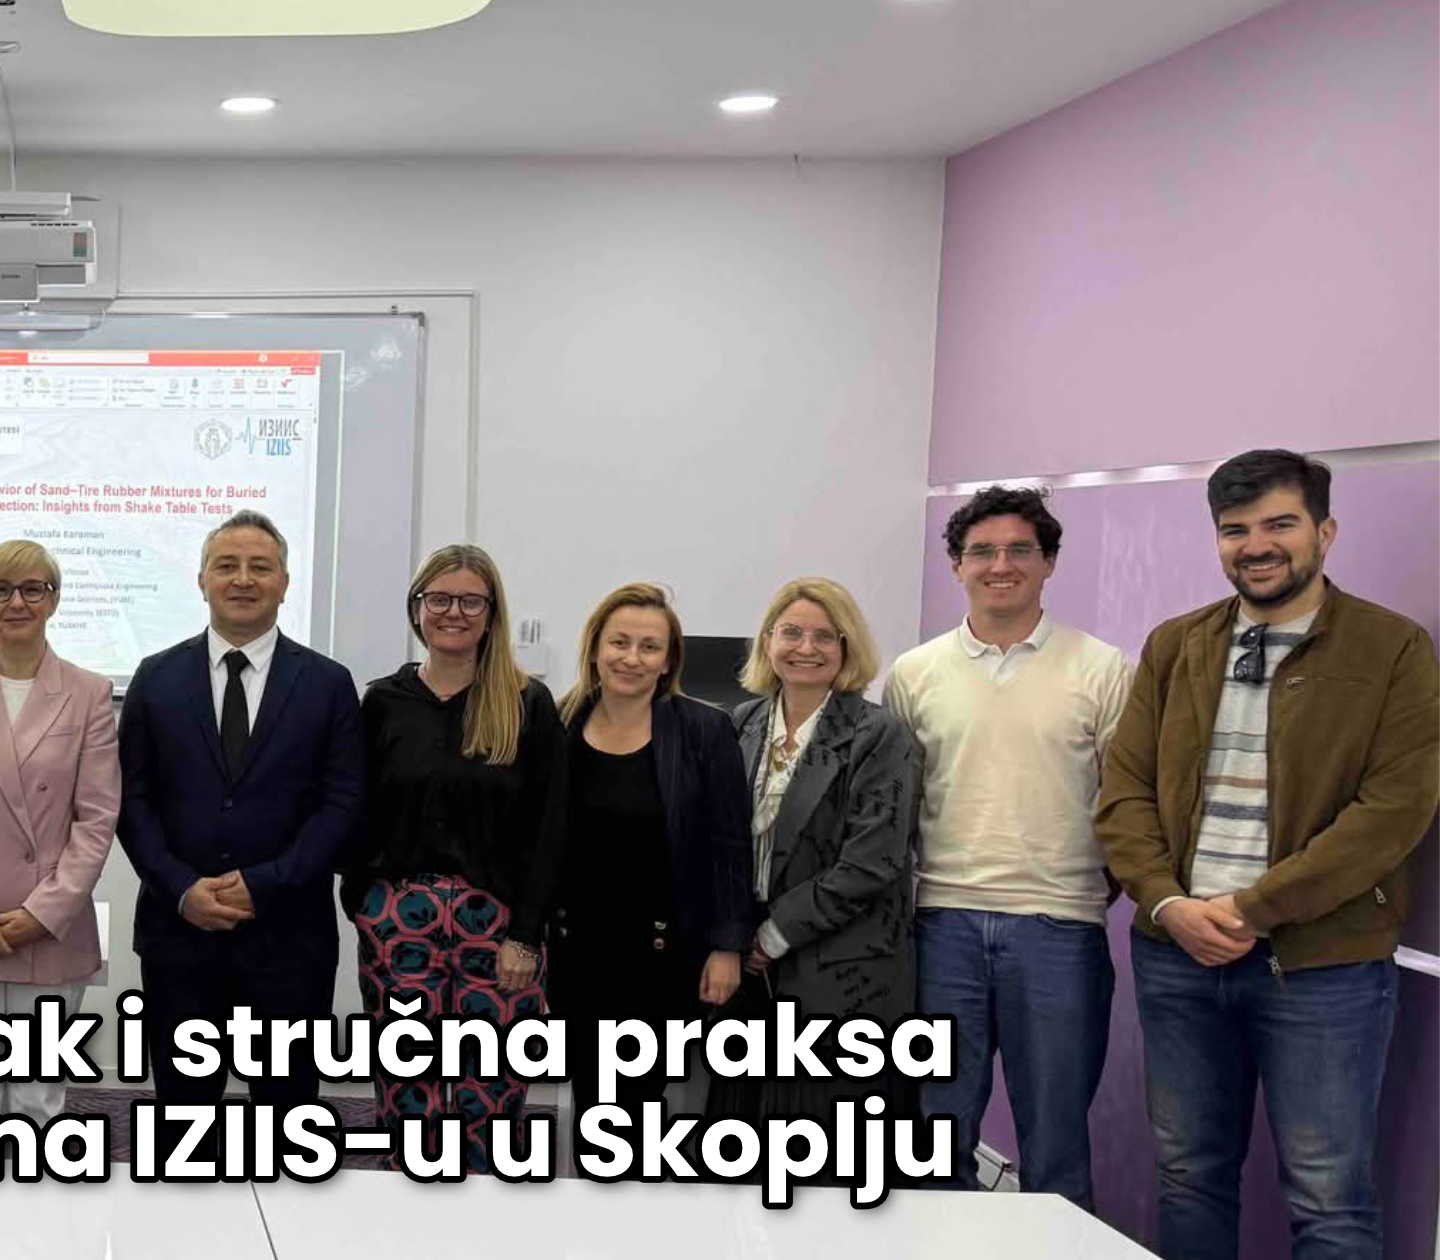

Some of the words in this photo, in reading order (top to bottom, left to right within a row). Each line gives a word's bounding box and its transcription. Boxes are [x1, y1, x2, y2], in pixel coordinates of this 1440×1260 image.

[266, 438, 292, 456] IZIIS
[24, 484, 37, 496] of
[103, 485, 148, 497] Rubber
[150, 485, 202, 498] Mixtures
[205, 486, 223, 498] for
[226, 486, 267, 498] Buried
[42, 500, 90, 514] Insights
[93, 500, 122, 513] from
[124, 501, 162, 513] Shake
[165, 501, 197, 514] Table
[201, 502, 233, 514] Tests
[86, 546, 142, 558] Engineering
